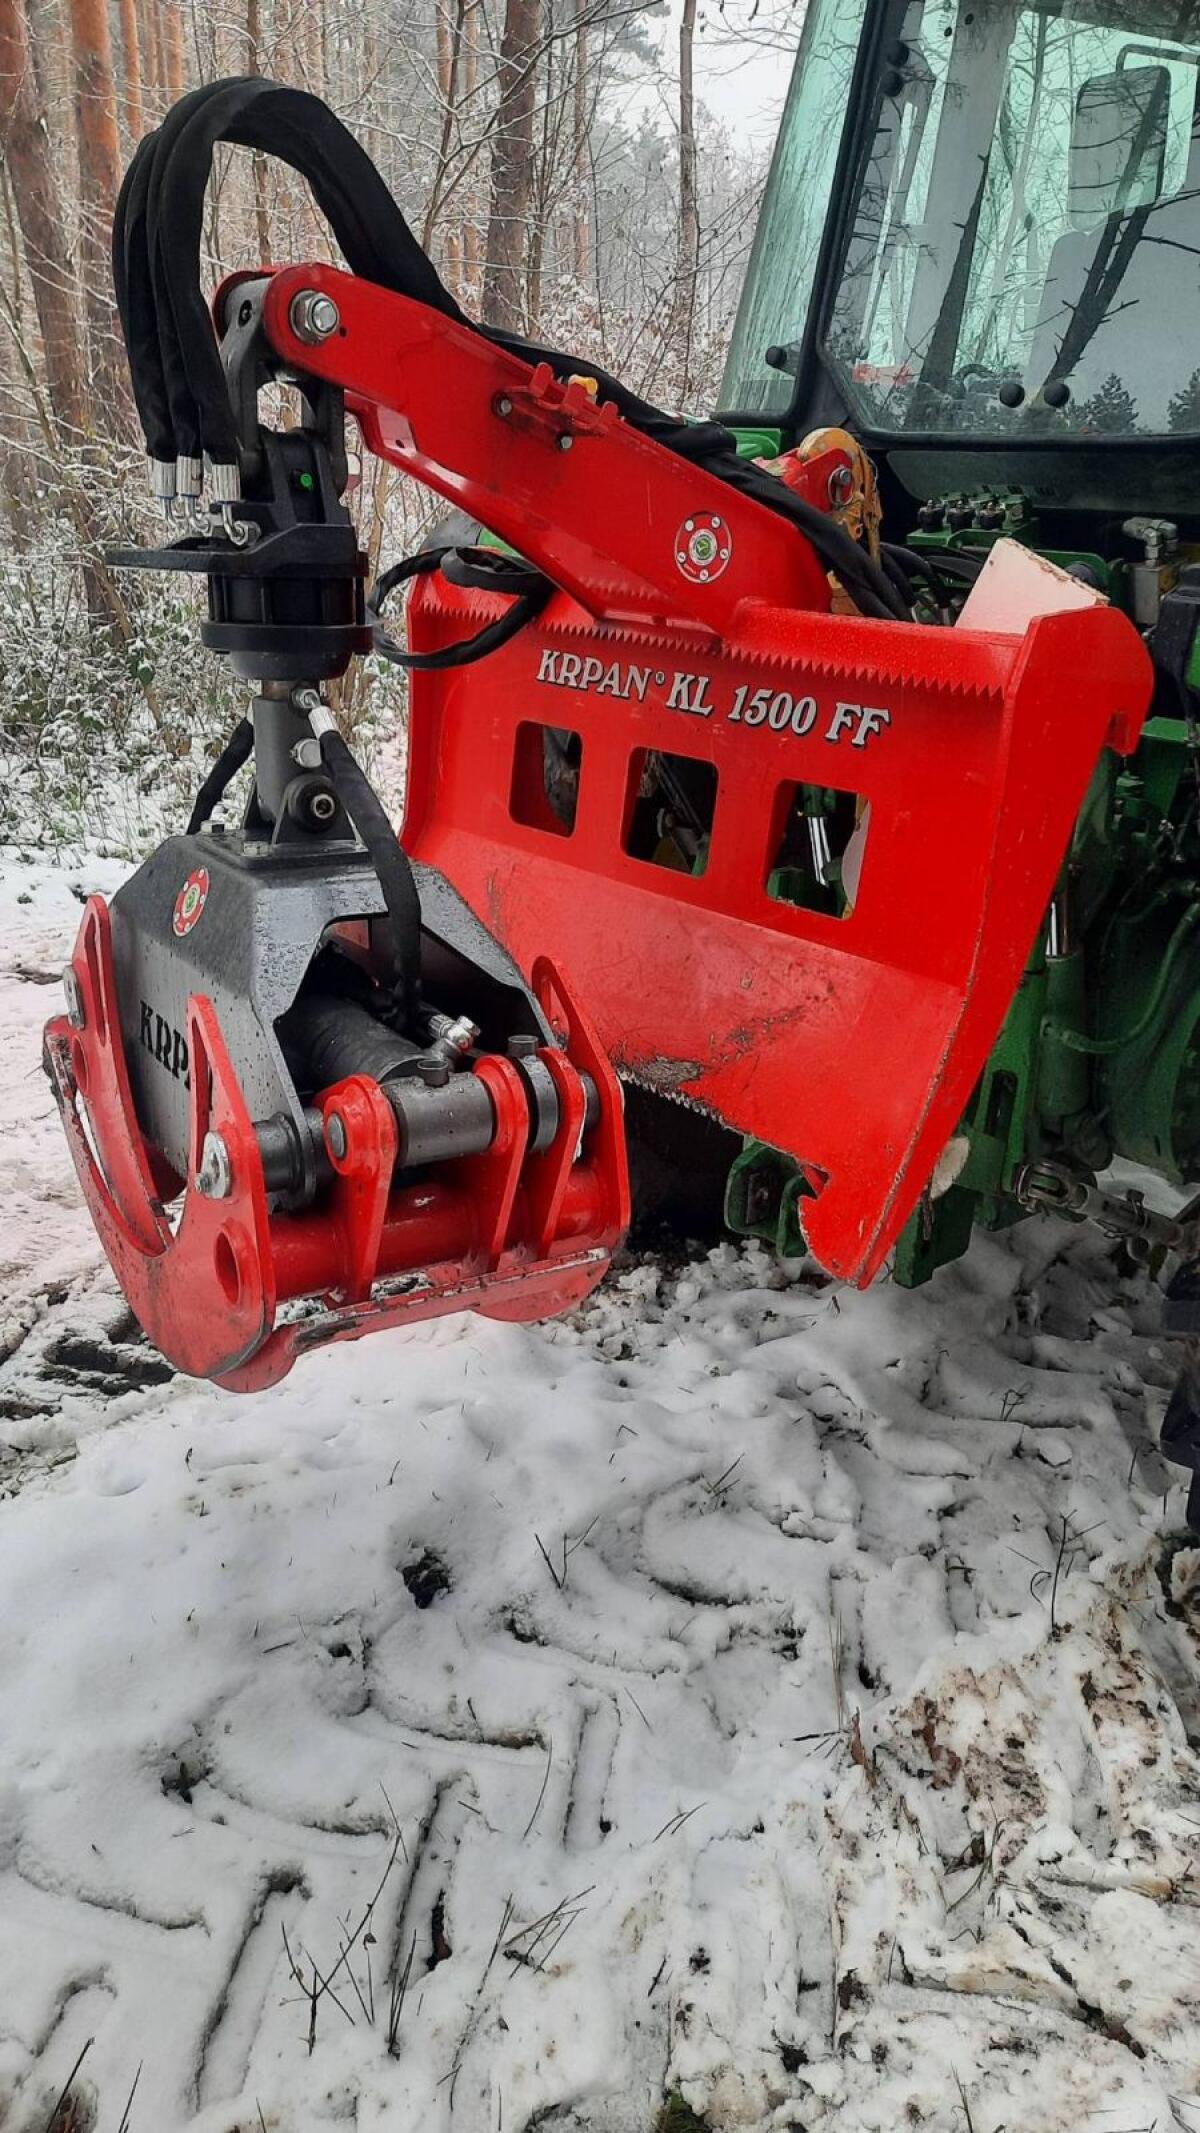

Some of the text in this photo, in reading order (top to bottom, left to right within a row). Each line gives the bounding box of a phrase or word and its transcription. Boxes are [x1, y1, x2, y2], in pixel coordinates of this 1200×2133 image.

[666, 672, 714, 716] KL
[727, 685, 818, 735] 1500
[825, 702, 891, 746] FF
[139, 1000, 213, 1111] KRP
